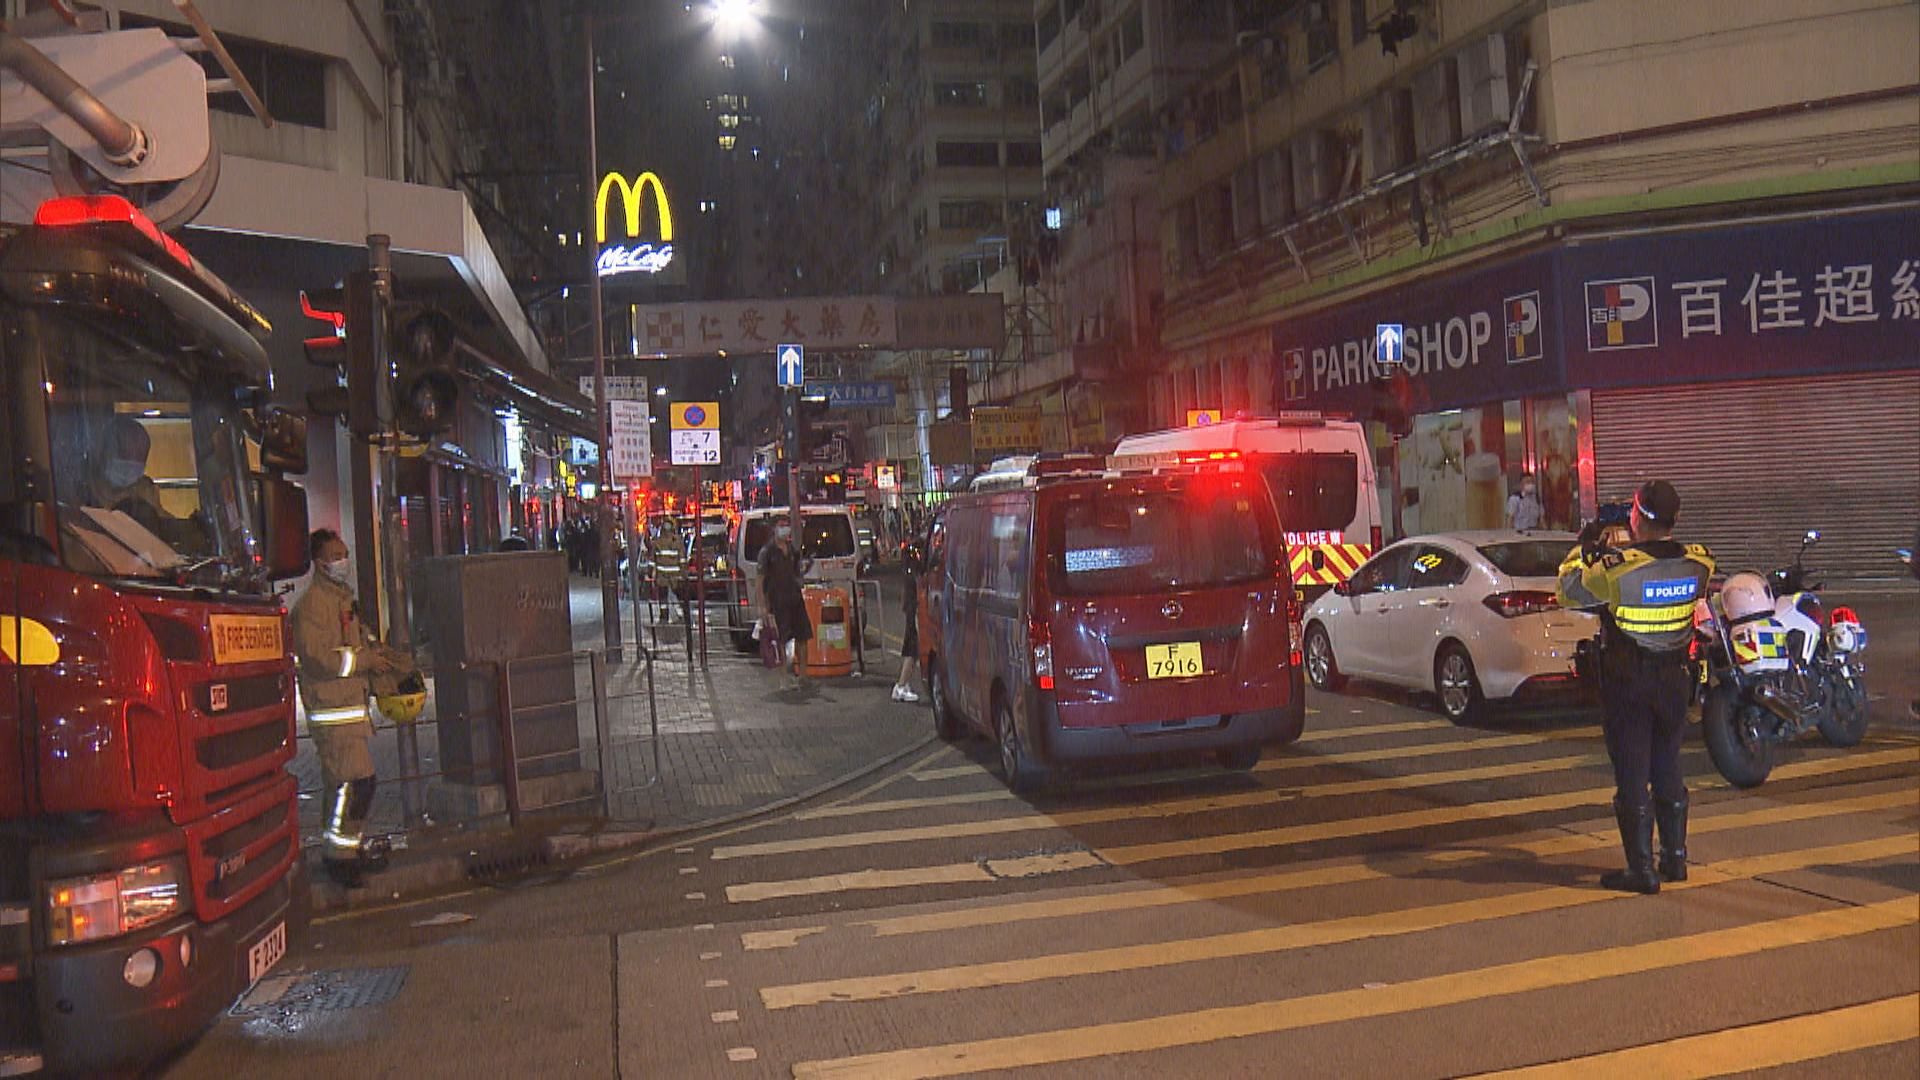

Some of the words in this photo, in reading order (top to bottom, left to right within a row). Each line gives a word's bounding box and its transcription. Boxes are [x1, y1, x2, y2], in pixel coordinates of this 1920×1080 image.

[700, 304, 881, 343] 仁愛大藥房
[1312, 312, 1492, 392] PARKSHOP
[703, 432, 711, 443] 7
[703, 450, 717, 461] 12
[1655, 583, 1688, 598] POLICE
[227, 625, 243, 652] FIRE
[244, 624, 274, 650] SERVICES
[1168, 645, 1178, 660] F
[1153, 659, 1198, 676] 7916
[254, 947, 260, 978] F
